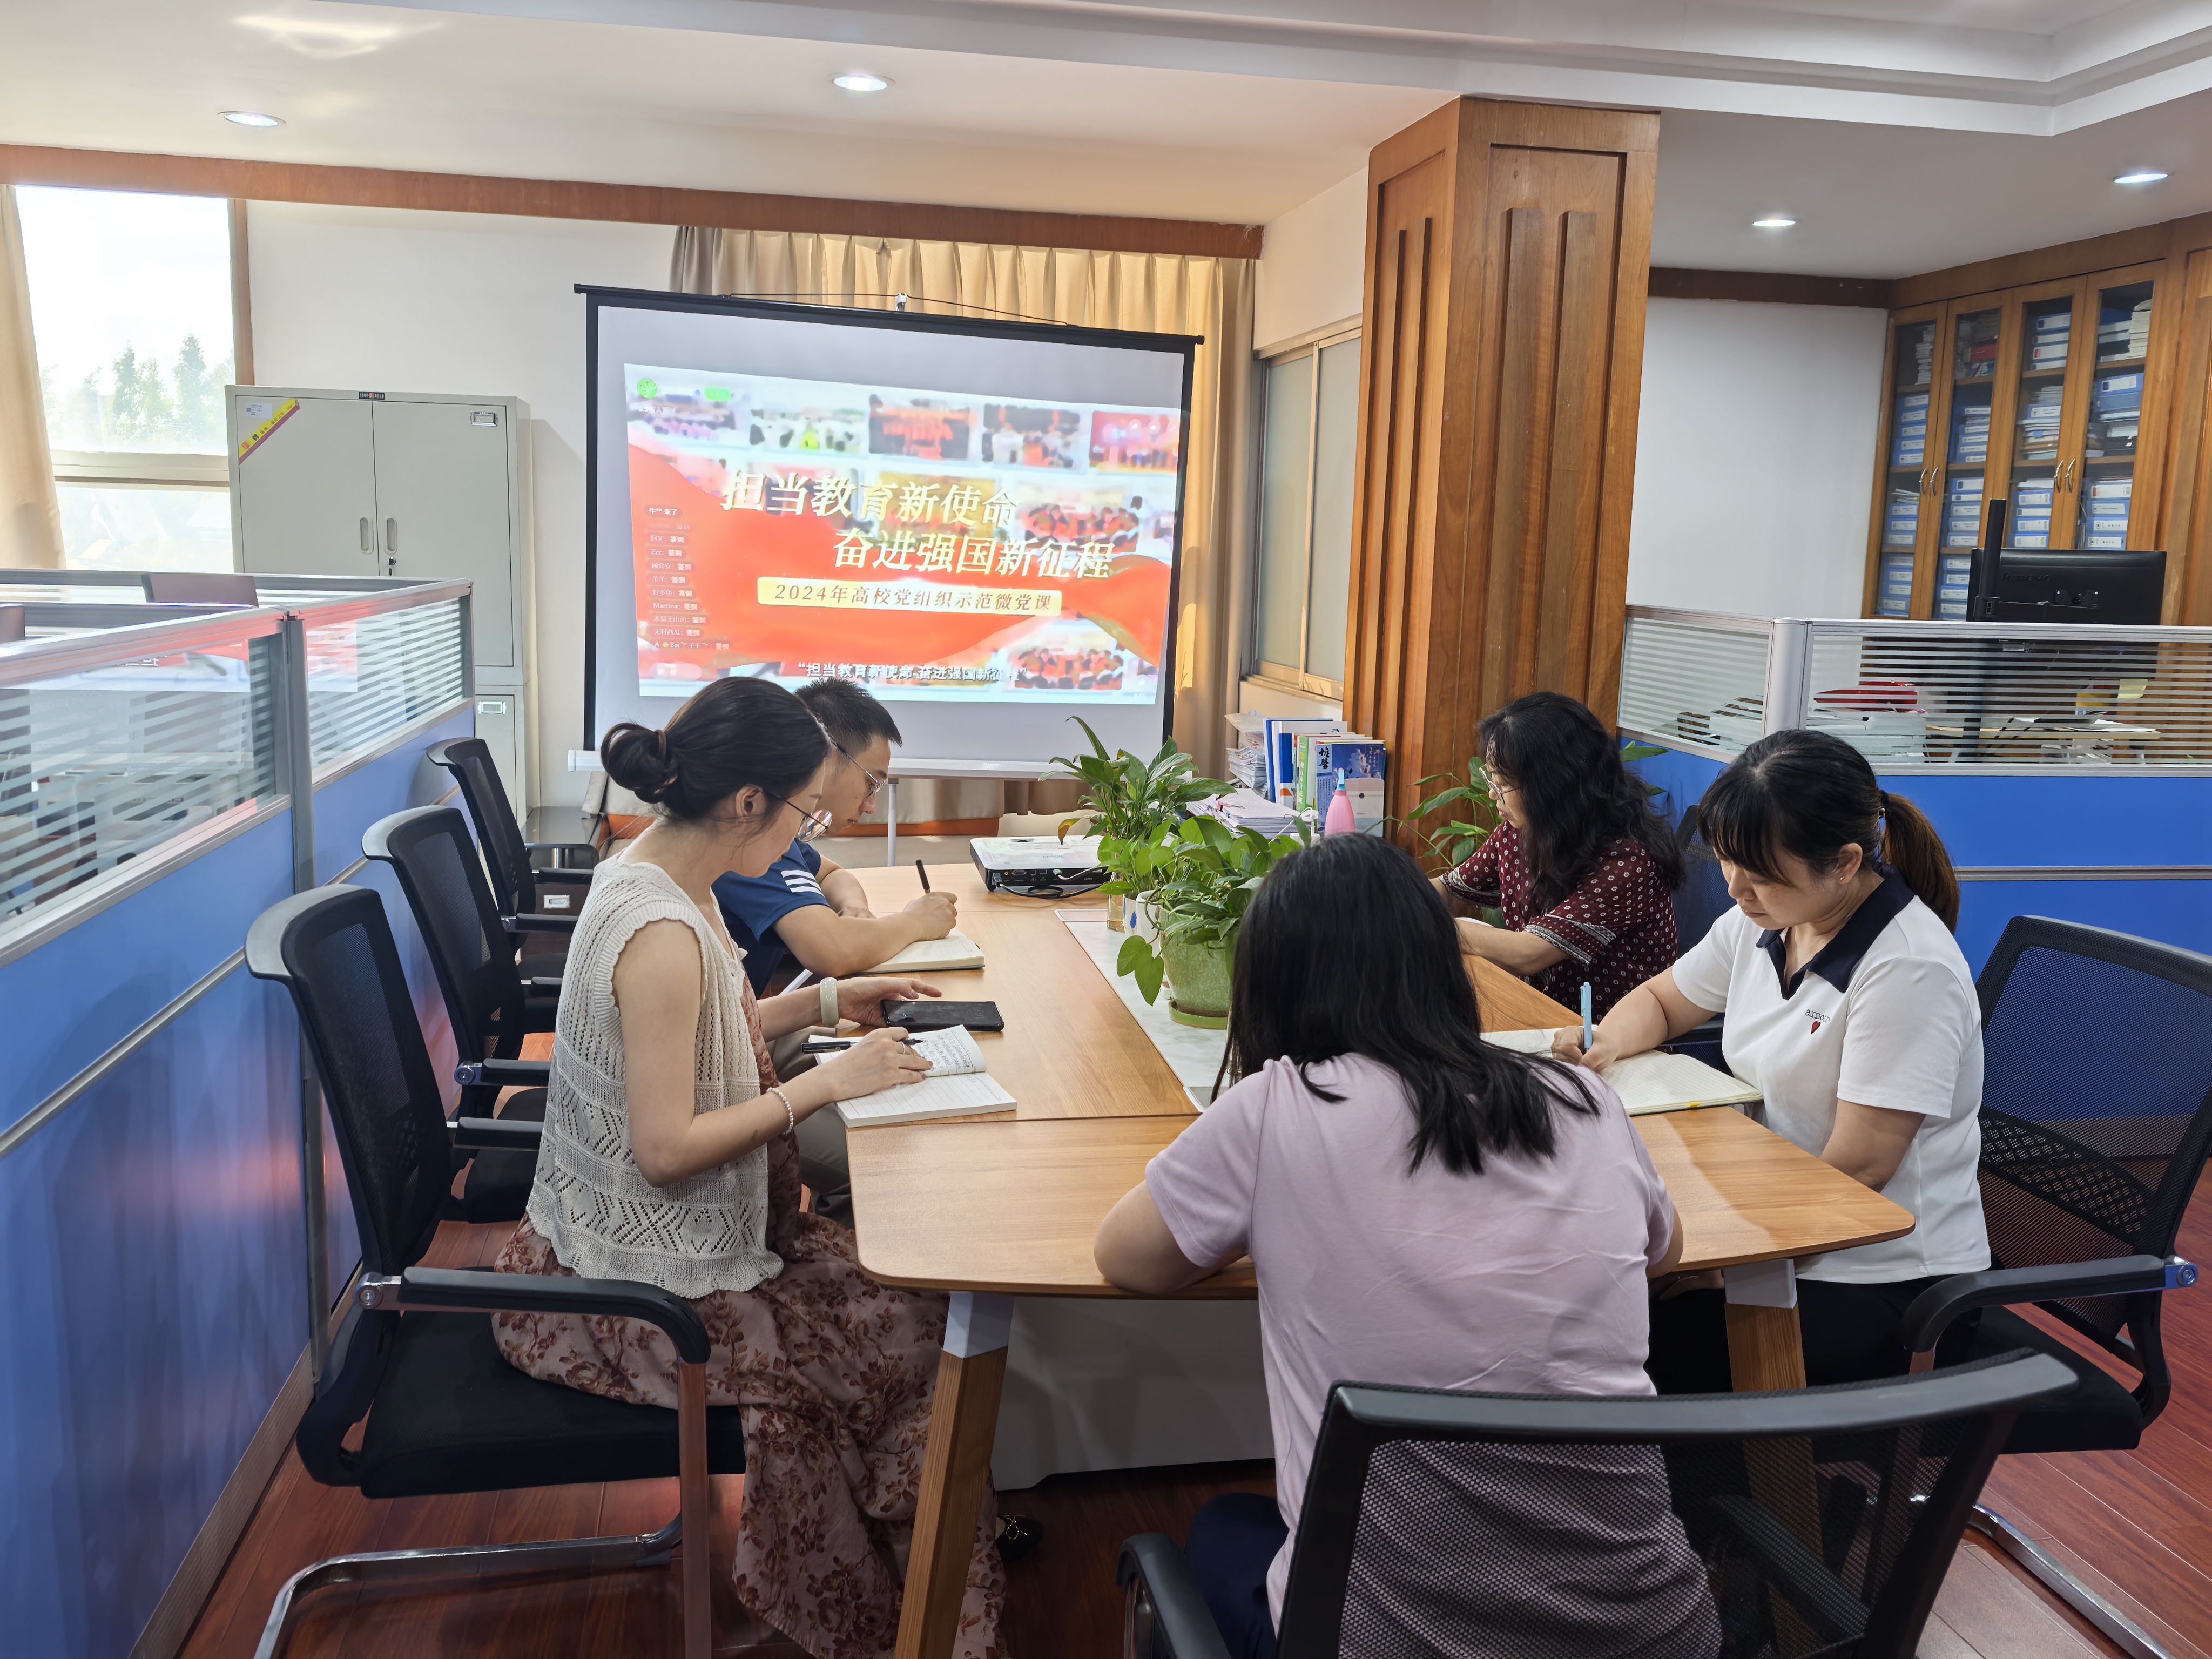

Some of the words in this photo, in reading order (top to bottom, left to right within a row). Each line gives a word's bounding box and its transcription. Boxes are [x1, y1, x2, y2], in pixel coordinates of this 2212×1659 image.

[720, 469, 1020, 528] 担当教育新使命
[833, 527, 1114, 579] 奋进强国新征程
[774, 583, 1053, 612] 2024年高校党组织示范微党课
